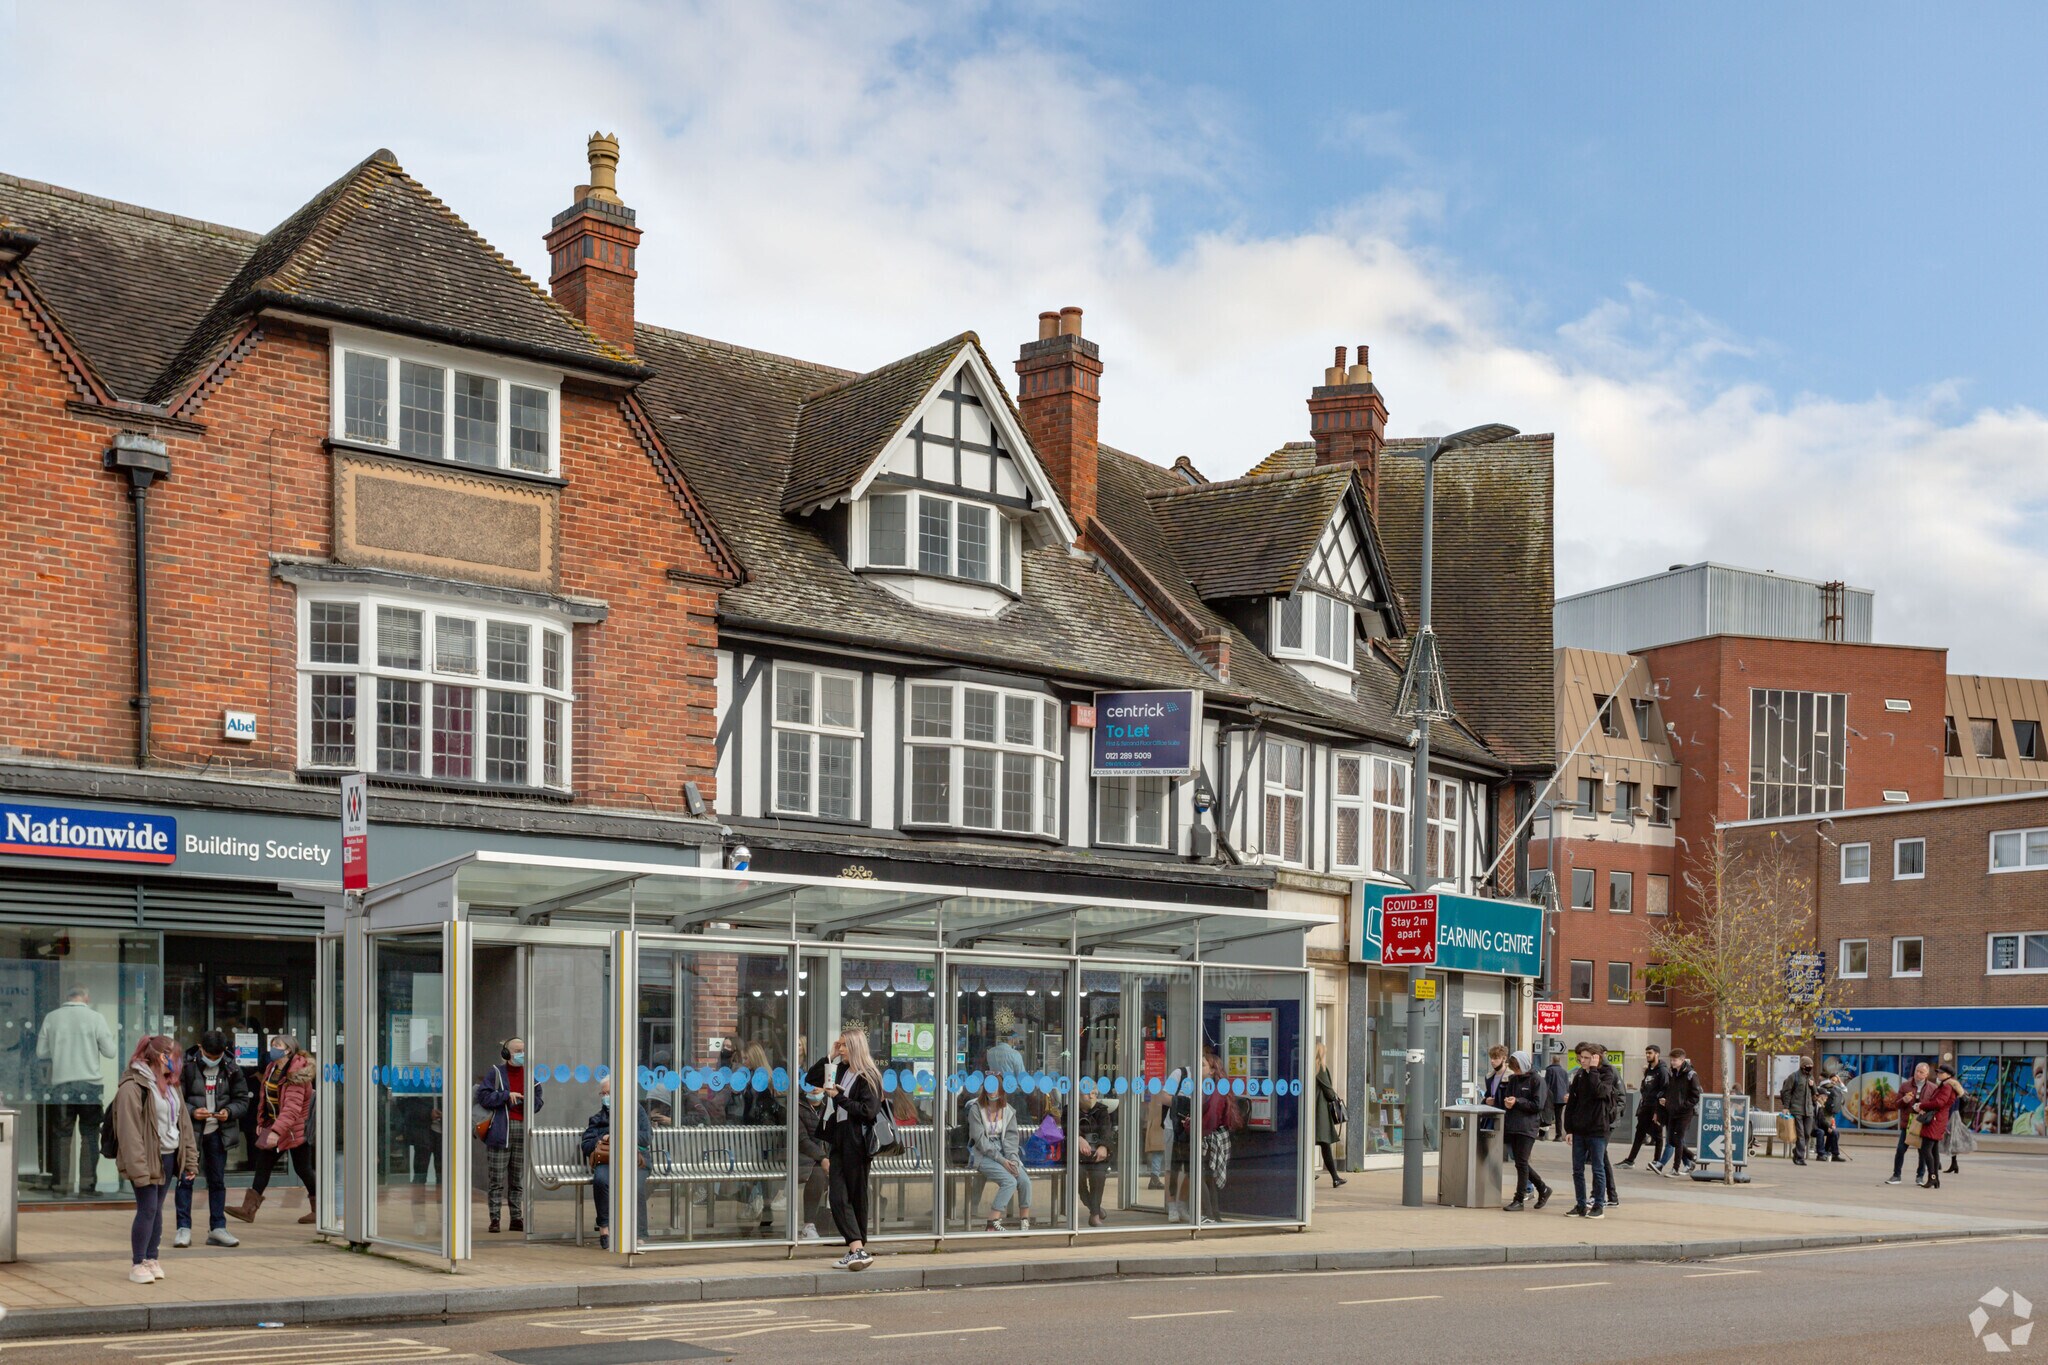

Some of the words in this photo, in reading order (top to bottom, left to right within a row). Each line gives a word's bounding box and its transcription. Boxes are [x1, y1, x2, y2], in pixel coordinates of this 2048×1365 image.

[1106, 702, 1165, 718] centrick
[227, 717, 255, 733] Abel
[1106, 725, 1124, 739] To
[1127, 724, 1150, 739] Let
[1105, 752, 1119, 760] 0121
[1119, 752, 1133, 760] 289
[1134, 752, 1152, 760] 5009
[5, 811, 169, 852] Nationwide
[184, 833, 260, 862] Building
[265, 839, 331, 866] Society
[1391, 916, 1412, 928] Stay
[1413, 916, 1428, 926] 2m
[1397, 928, 1421, 940] apart
[1437, 924, 1491, 950] EARNING
[1494, 931, 1534, 955] CENTRE
[1098, 1063, 1120, 1071] GOLDE
[1702, 1123, 1723, 1132] OPEN
[1730, 1125, 1744, 1133] OW
